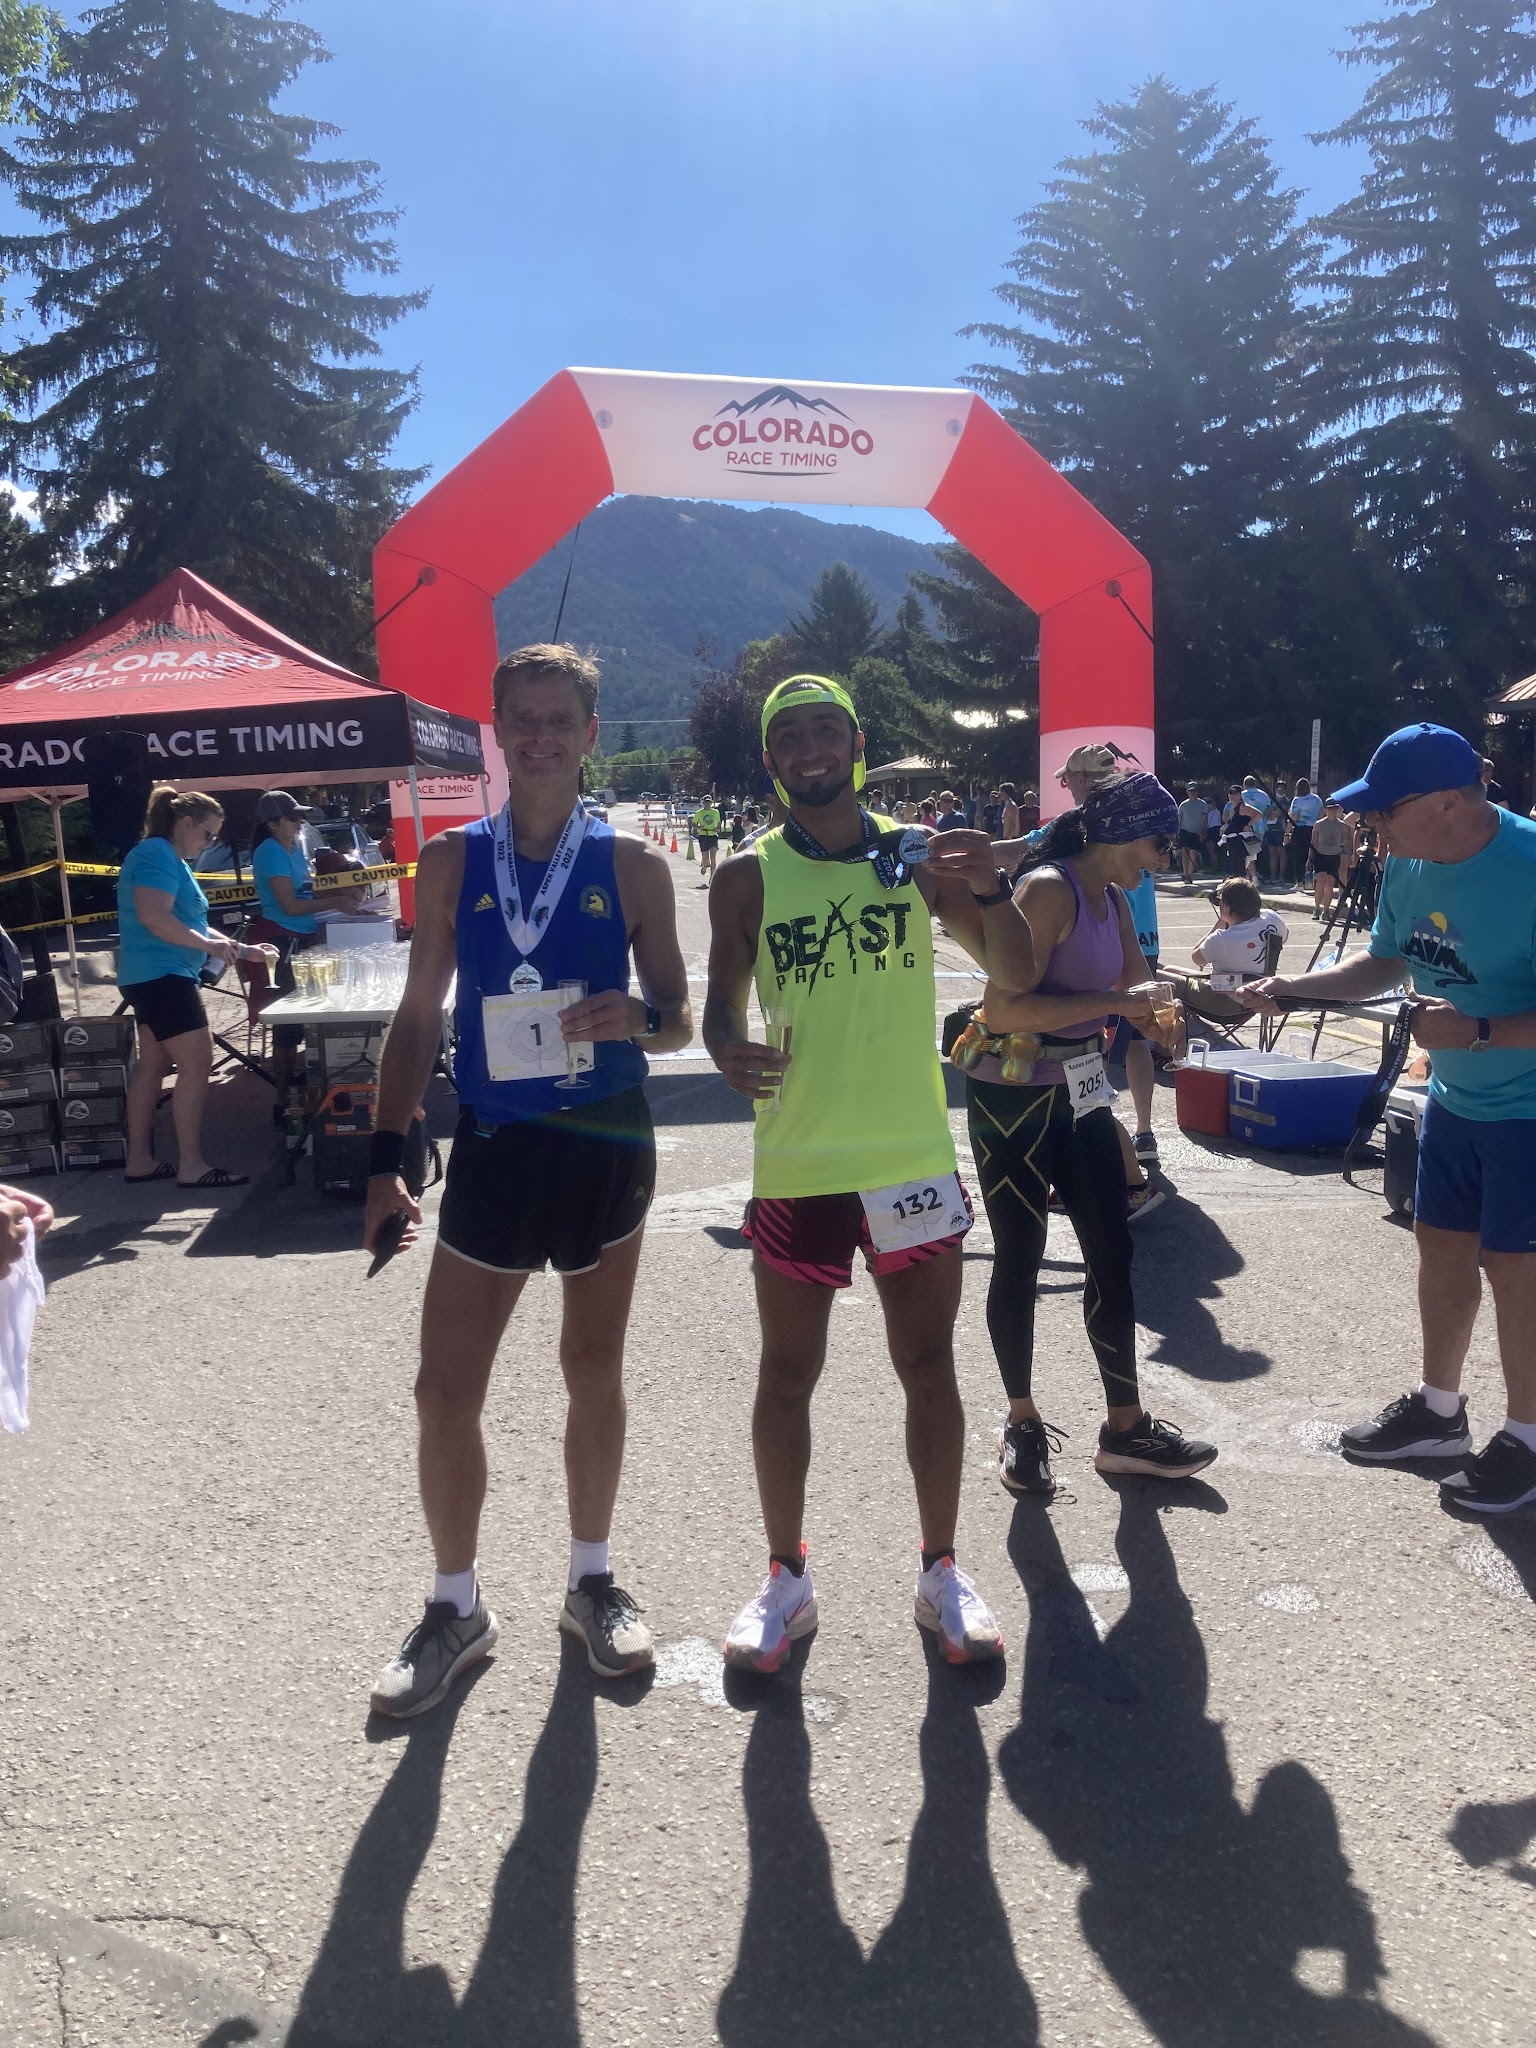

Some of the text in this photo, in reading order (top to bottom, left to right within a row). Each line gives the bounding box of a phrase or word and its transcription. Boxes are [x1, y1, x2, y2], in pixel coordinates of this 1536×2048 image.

[692, 417, 874, 456] COLORADO
[726, 451, 838, 467] RACE TIMING
[14, 650, 282, 691] COLORADO
[58, 670, 224, 693] RACE TIMING
[779, 692, 819, 707] lululemon
[147, 729, 219, 758] ACE
[229, 719, 363, 754] TIMING
[439, 784, 474, 794] TIMING
[540, 818, 575, 896] ASPEN VALLEY MARATHON
[560, 847, 575, 870] 2022
[352, 866, 408, 883] CAUTION
[206, 886, 257, 901] CAUTIO
[765, 894, 912, 976] BEAST
[530, 1022, 543, 1046] 1
[1391, 1022, 1403, 1046] 2022
[892, 1187, 943, 1219] 132
